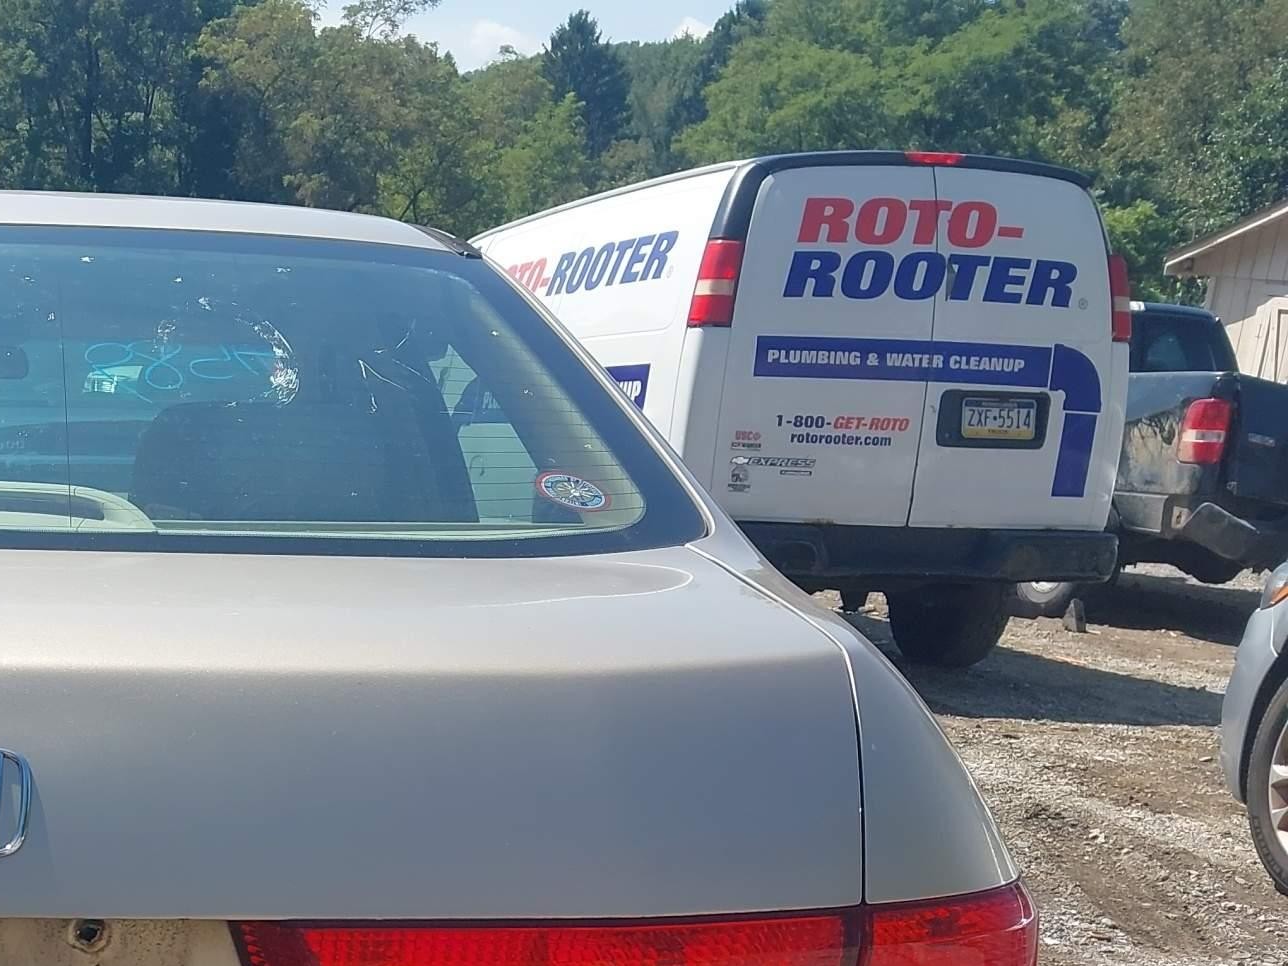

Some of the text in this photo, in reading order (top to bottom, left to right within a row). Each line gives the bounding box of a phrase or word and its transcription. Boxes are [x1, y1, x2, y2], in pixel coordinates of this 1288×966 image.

[797, 197, 1025, 248] ROTO-
[782, 250, 1078, 308] ROOTER
[767, 349, 1025, 373] PLUMBING & WATER CLEANUP
[776, 414, 910, 432] 1-800-GET-ROTO
[790, 431, 892, 447] rotorooter.com
[748, 456, 816, 468] EXPRESS
